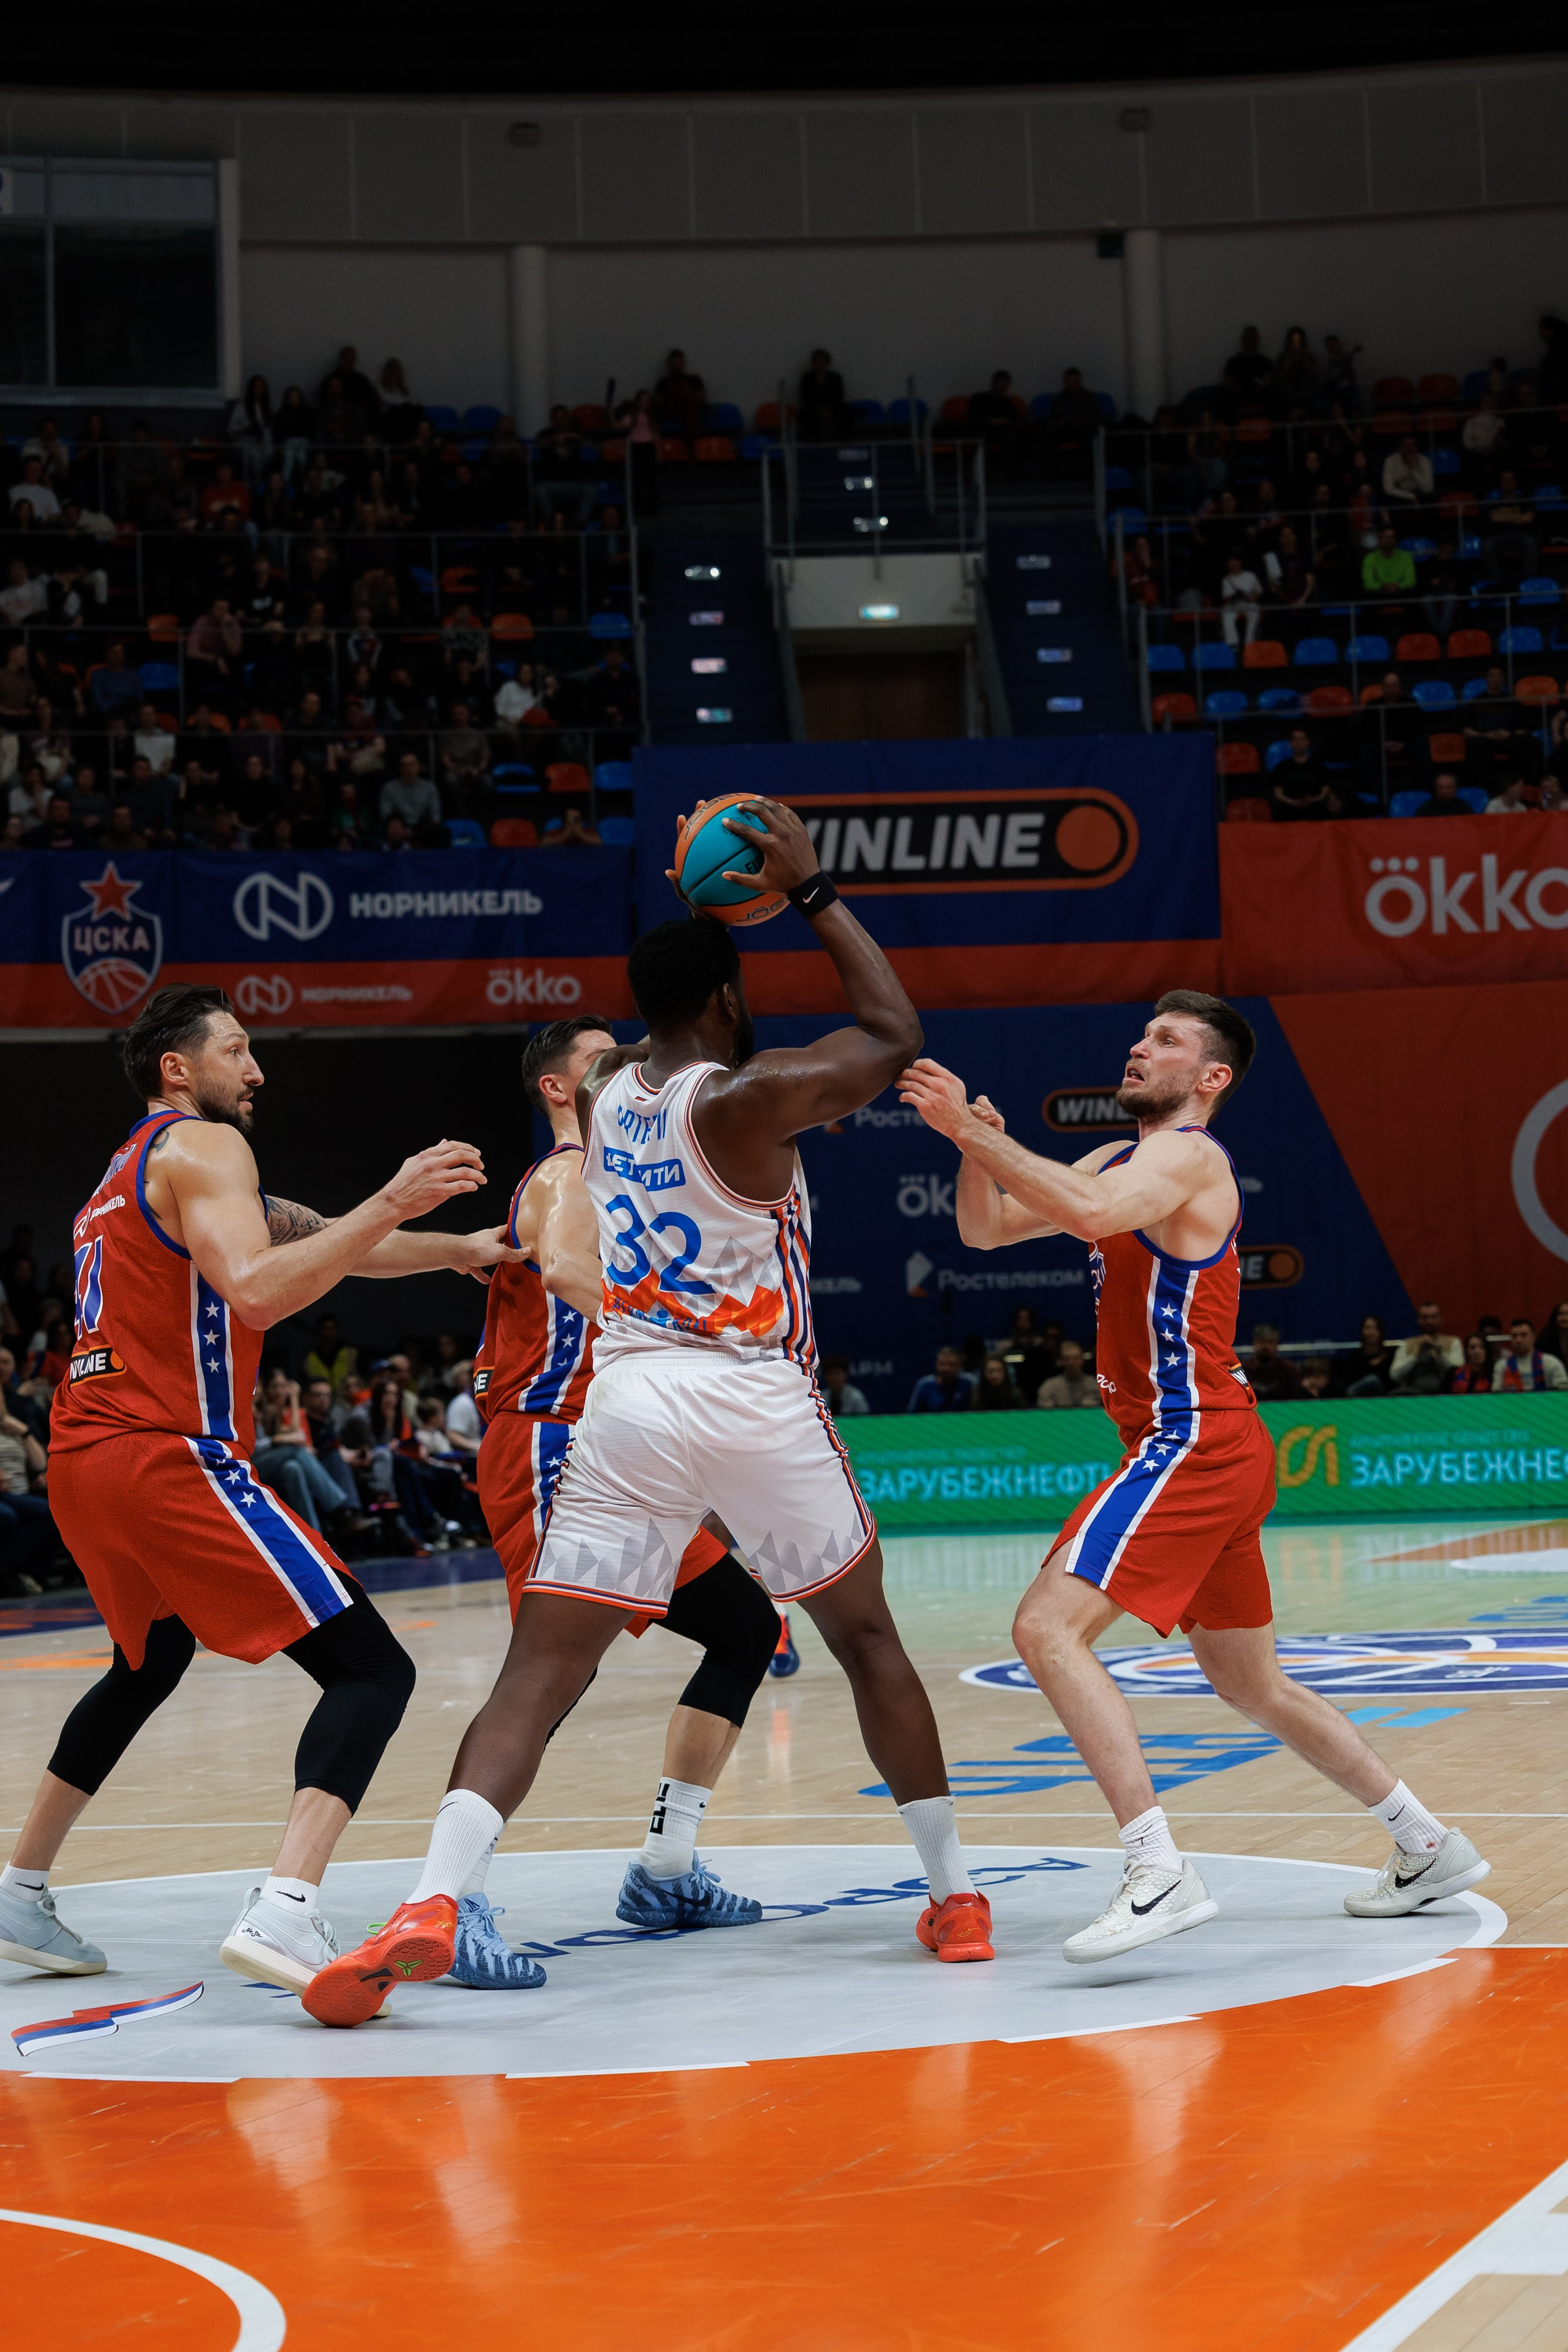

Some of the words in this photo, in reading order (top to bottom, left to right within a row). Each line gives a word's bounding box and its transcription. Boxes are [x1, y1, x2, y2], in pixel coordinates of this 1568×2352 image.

[349, 889, 544, 918] НОРНИКЕЛЬ
[73, 925, 151, 956] ЦСКА
[1057, 1096, 1137, 1123] WINL
[606, 1194, 717, 1296] 32
[938, 1268, 1085, 1292] Ростелеком
[1350, 1446, 1568, 1488] ЗАРУБЕЖНЕ
